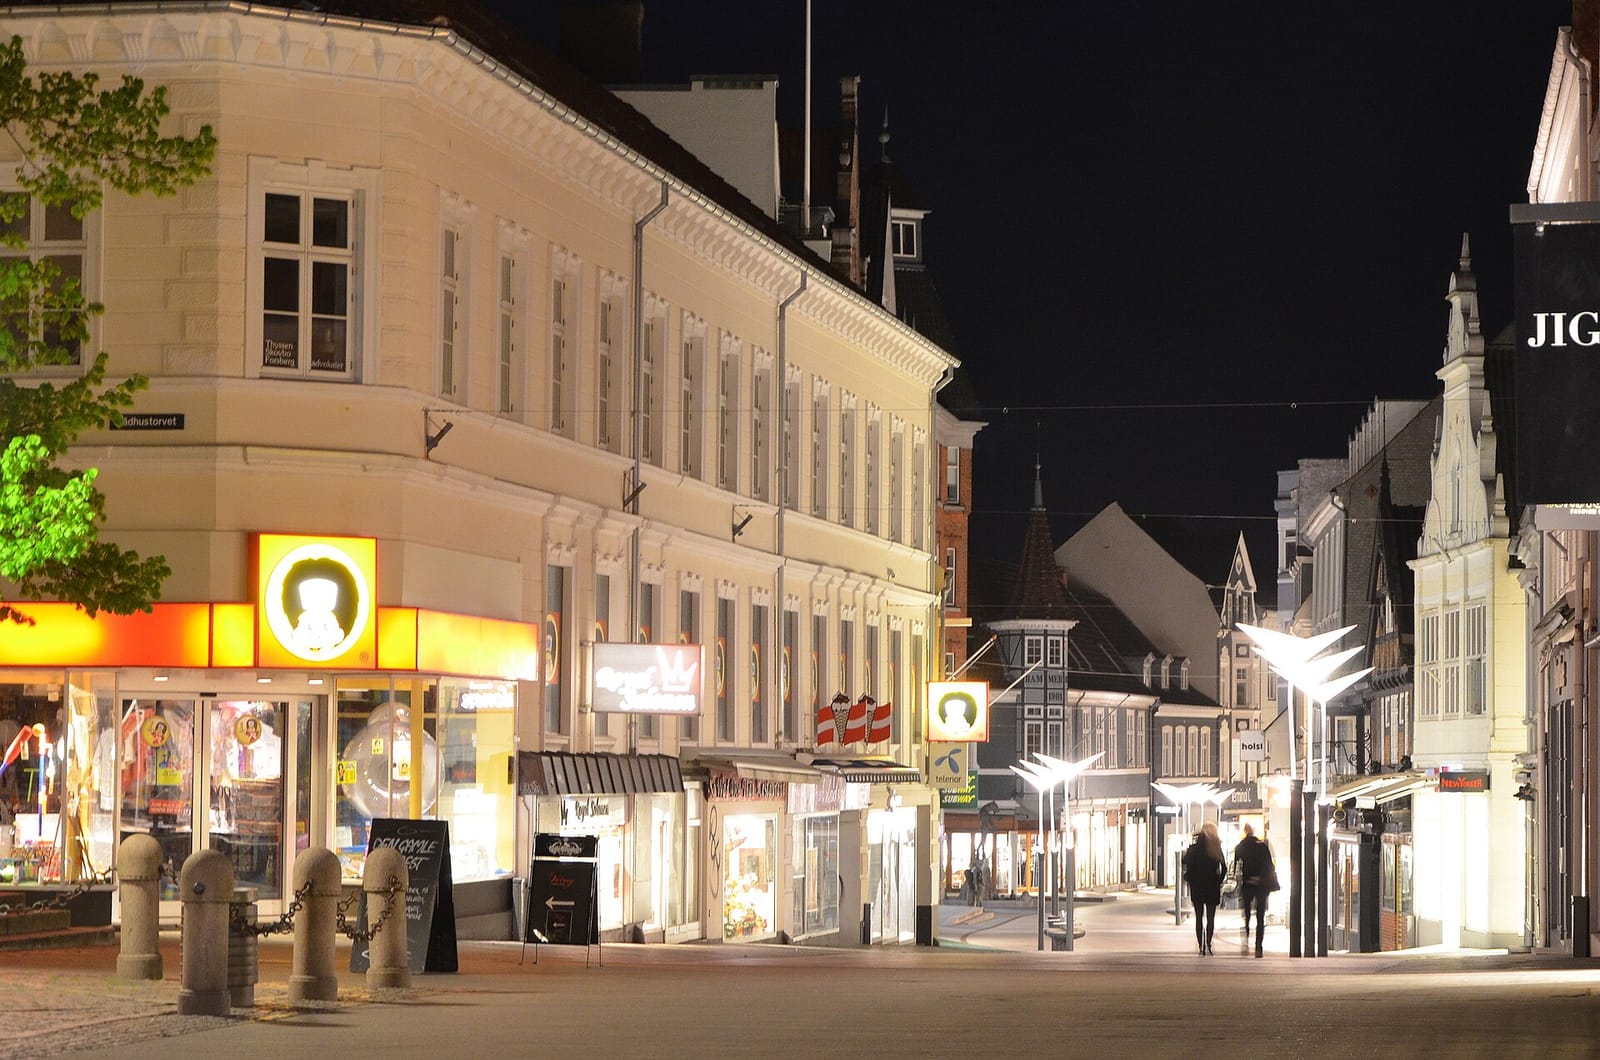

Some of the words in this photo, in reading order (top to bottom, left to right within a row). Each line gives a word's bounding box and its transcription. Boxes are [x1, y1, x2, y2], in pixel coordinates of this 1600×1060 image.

[1527, 311, 1600, 347] JIG
[935, 775, 962, 784] telenor
[942, 795, 976, 803] SUBWAY
